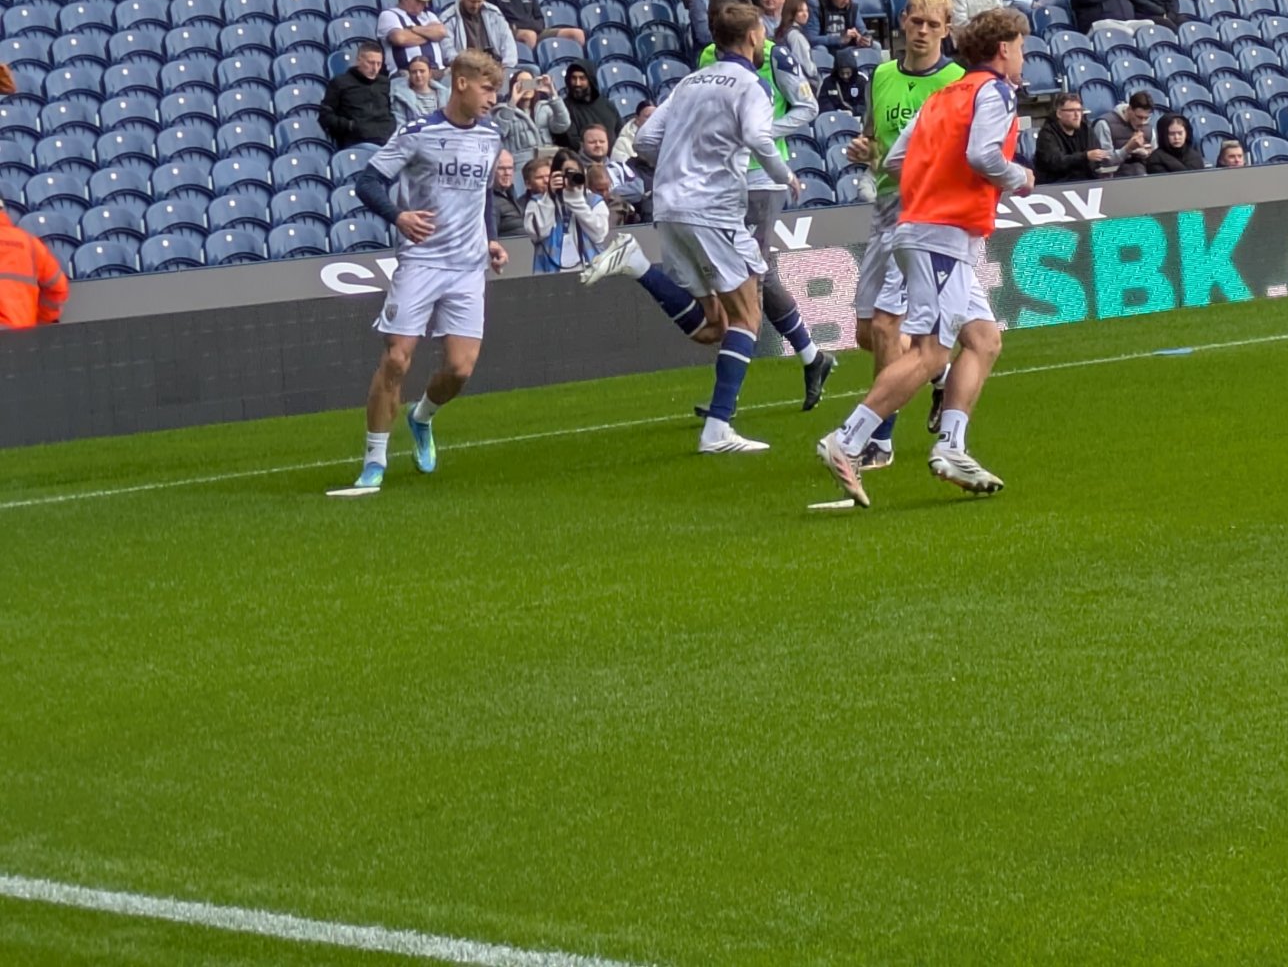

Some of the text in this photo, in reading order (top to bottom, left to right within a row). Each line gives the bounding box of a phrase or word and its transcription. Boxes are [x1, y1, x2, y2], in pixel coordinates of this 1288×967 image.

[684, 73, 737, 89] macron
[886, 102, 918, 122] ide
[439, 156, 488, 179] ideal
